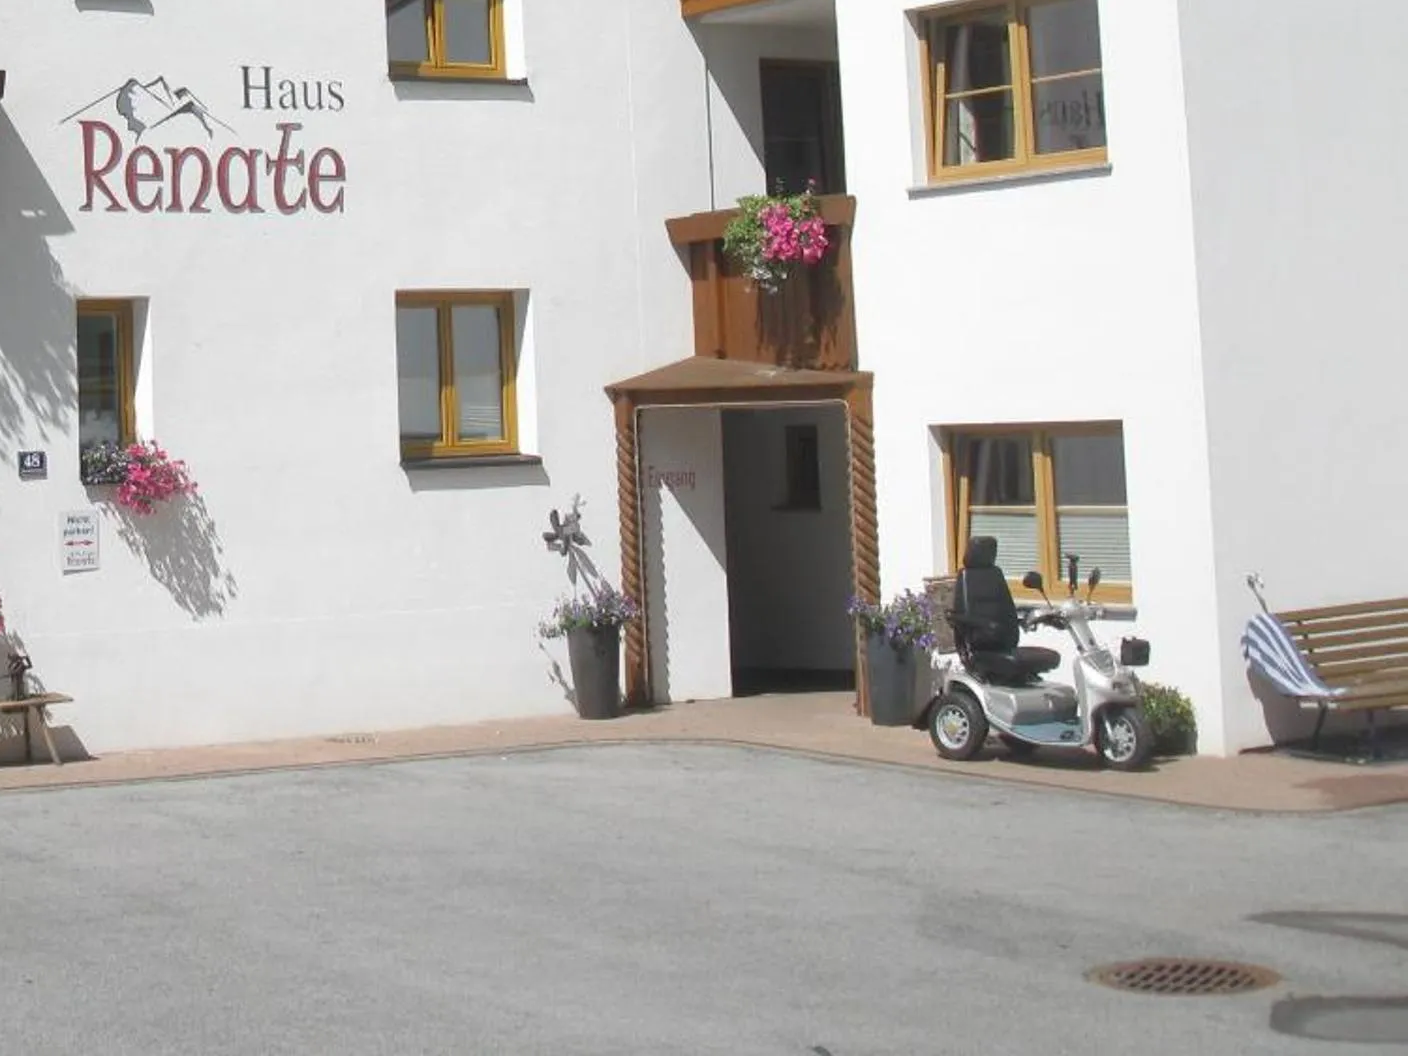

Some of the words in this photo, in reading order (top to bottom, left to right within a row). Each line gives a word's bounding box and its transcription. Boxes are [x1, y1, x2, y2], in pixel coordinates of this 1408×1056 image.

[240, 65, 345, 112] Haus
[77, 120, 347, 216] Renate
[24, 453, 40, 467] 48
